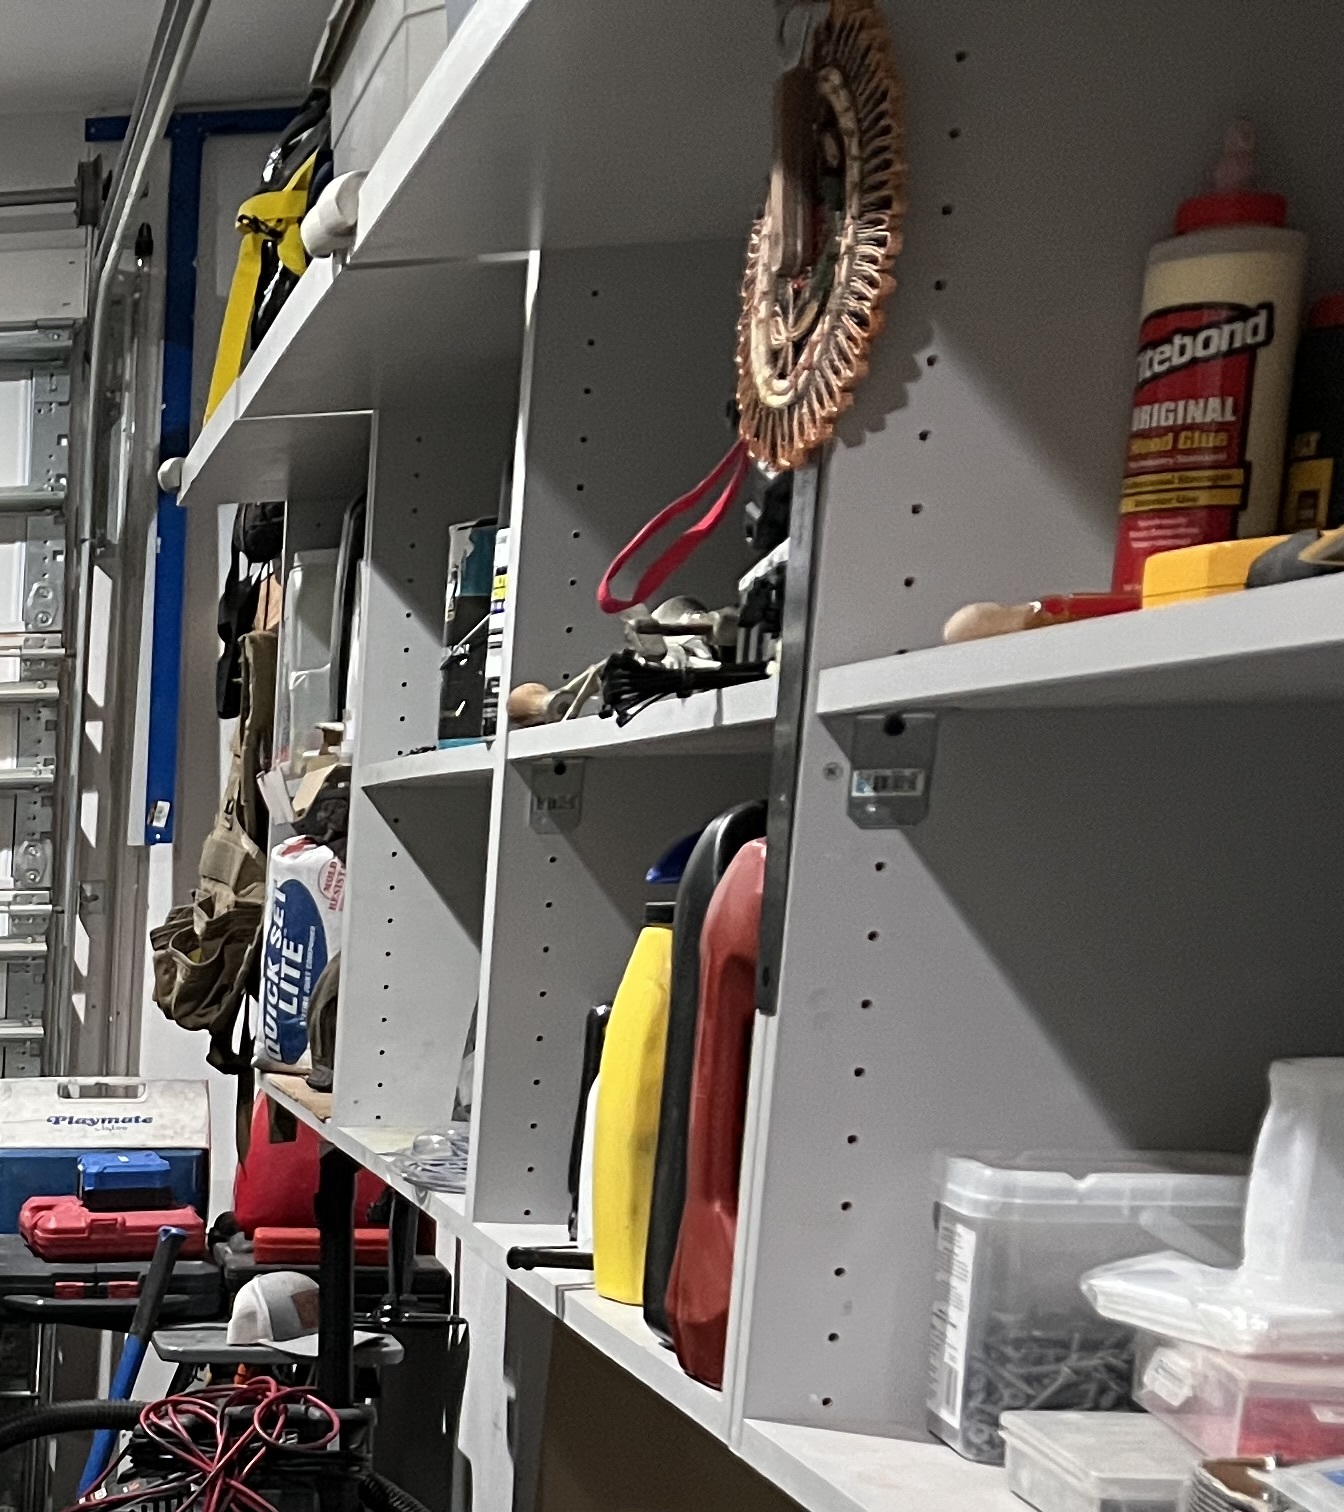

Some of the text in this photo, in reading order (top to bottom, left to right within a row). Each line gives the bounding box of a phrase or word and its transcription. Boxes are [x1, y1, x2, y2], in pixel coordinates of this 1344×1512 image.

[264, 880, 287, 1061] QUICK SET
[278, 938, 304, 1015] LITE
[46, 1115, 154, 1127] Playmate
